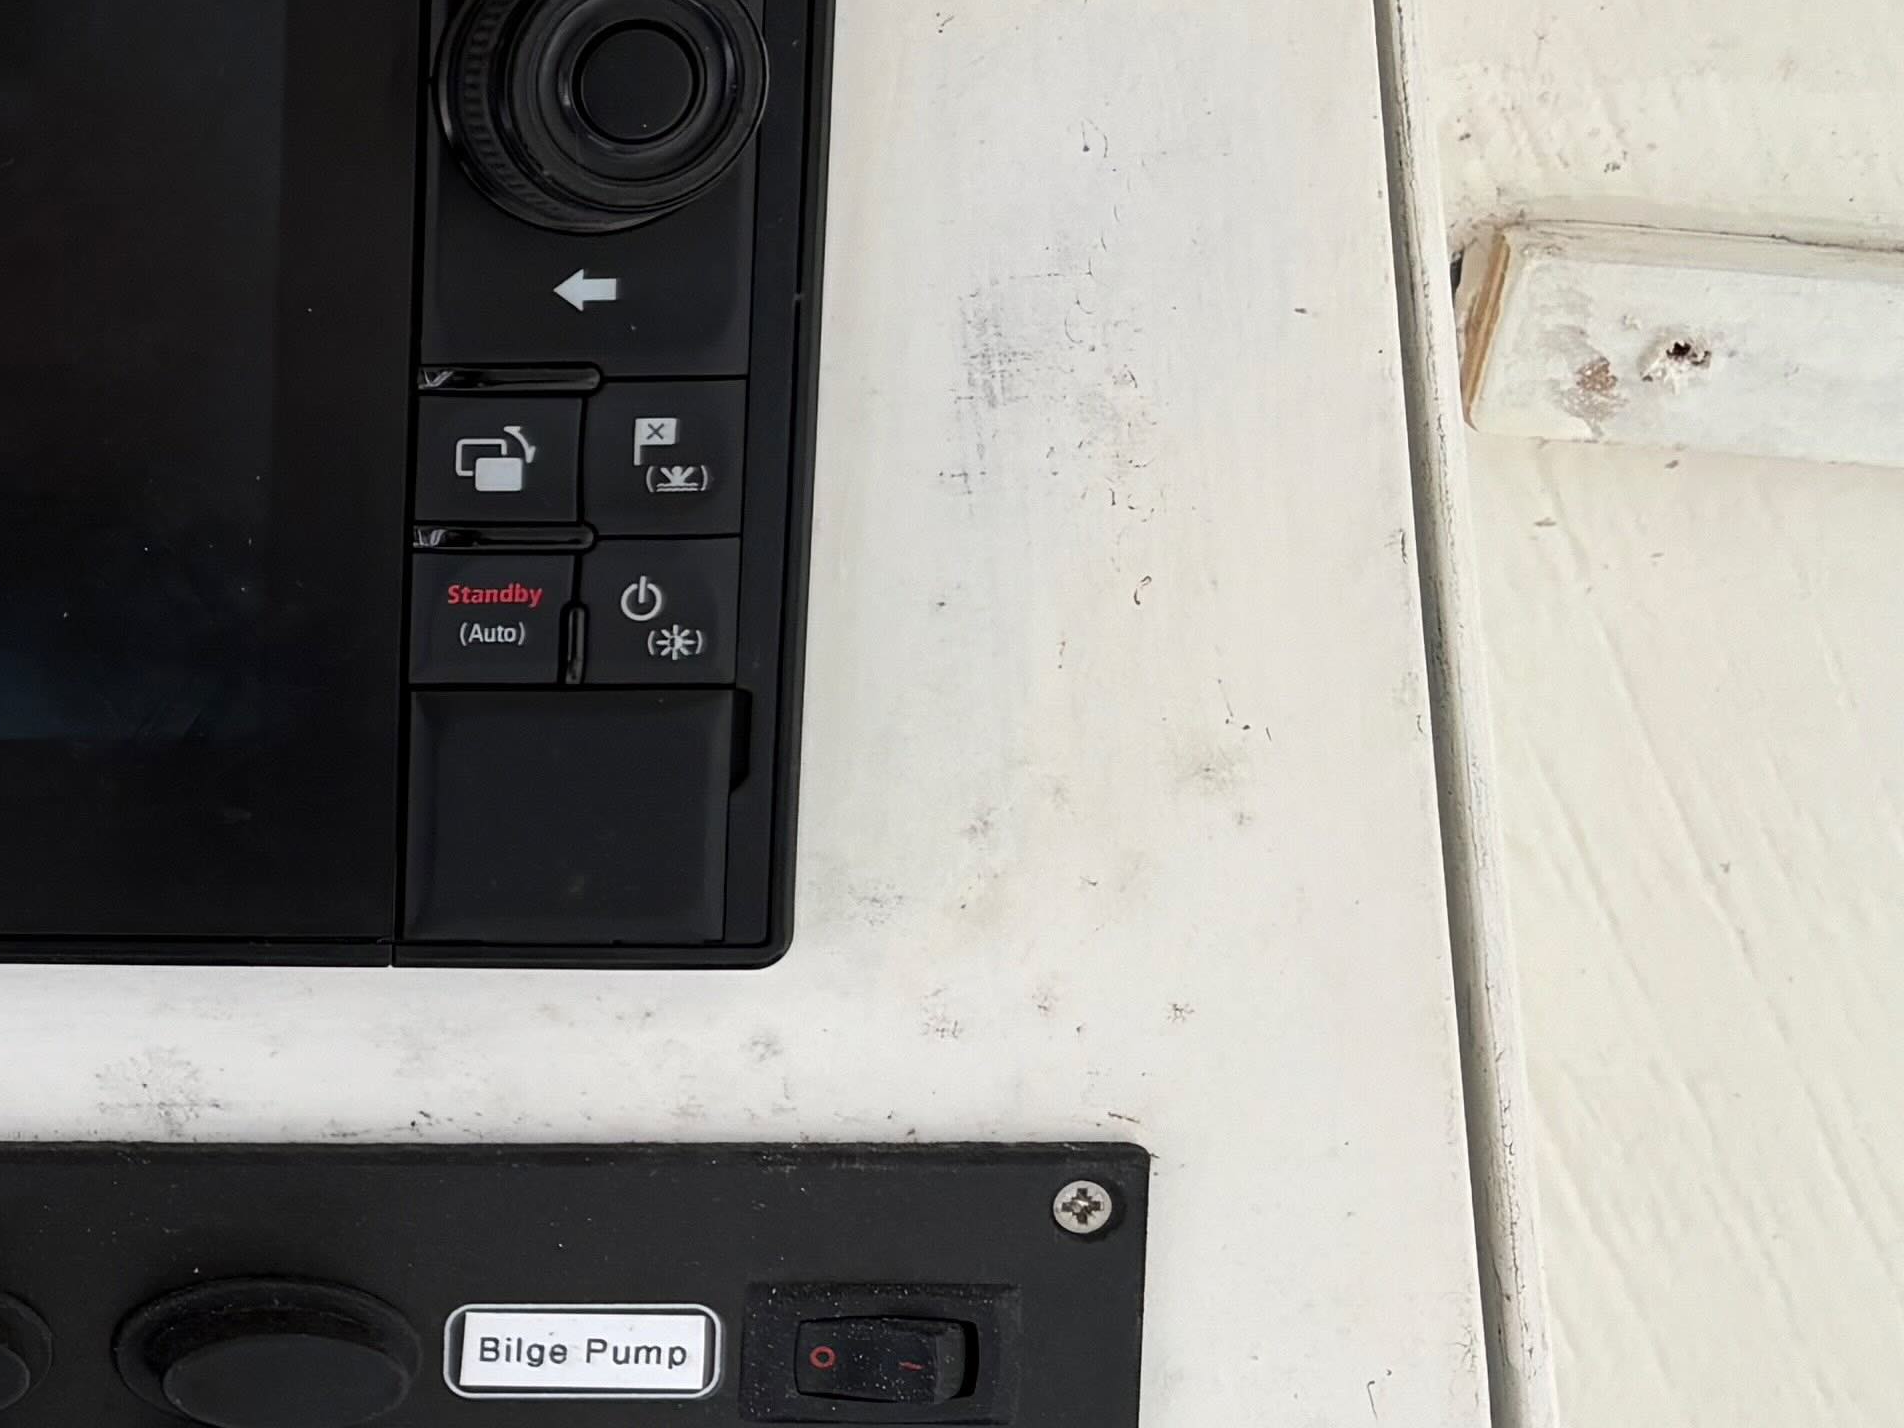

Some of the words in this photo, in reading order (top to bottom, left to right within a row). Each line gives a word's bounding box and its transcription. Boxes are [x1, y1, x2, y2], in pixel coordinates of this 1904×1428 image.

[447, 582, 543, 608] Standby
[459, 622, 526, 645] (Auto)
[479, 1336, 568, 1368] Bilge
[585, 1338, 687, 1370] Pump
